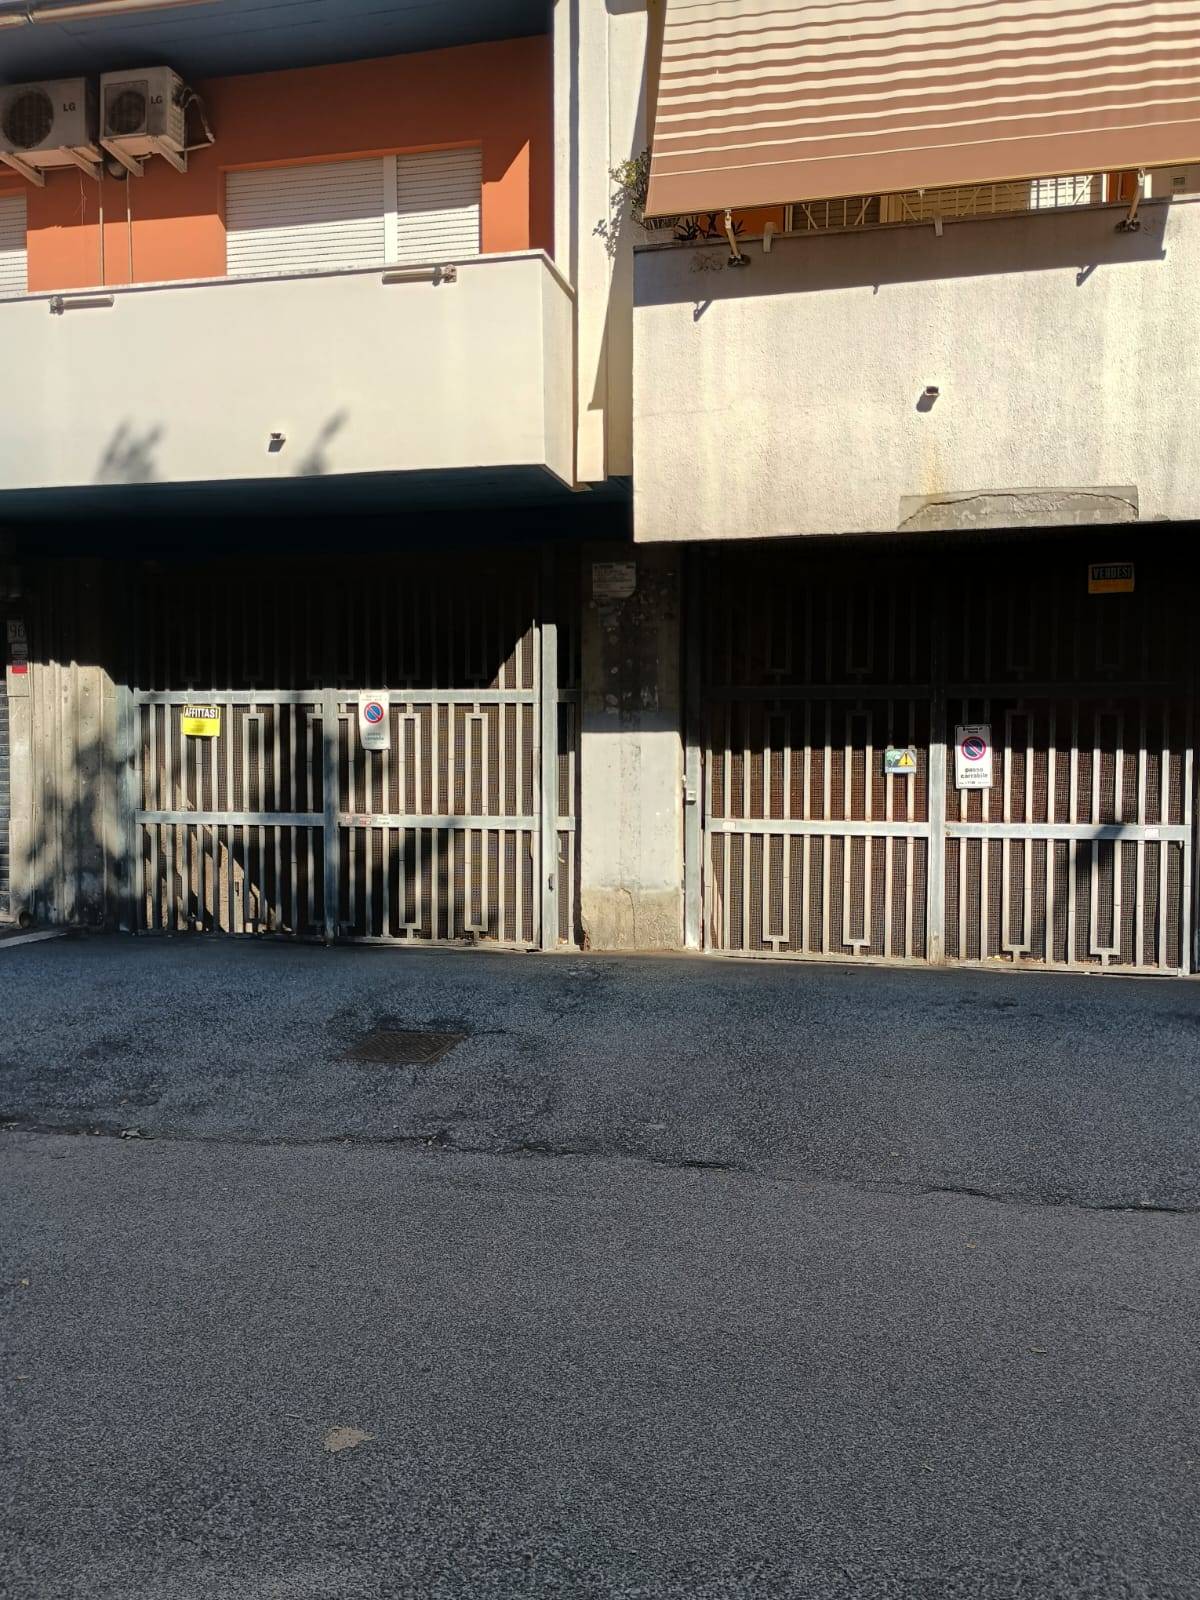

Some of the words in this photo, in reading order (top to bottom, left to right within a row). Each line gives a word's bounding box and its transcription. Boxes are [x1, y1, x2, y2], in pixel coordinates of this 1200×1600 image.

[150, 95, 163, 105] LG
[63, 102, 76, 112] LG
[1093, 567, 1131, 579] VENDESI
[185, 707, 218, 719] AFFITTASI
